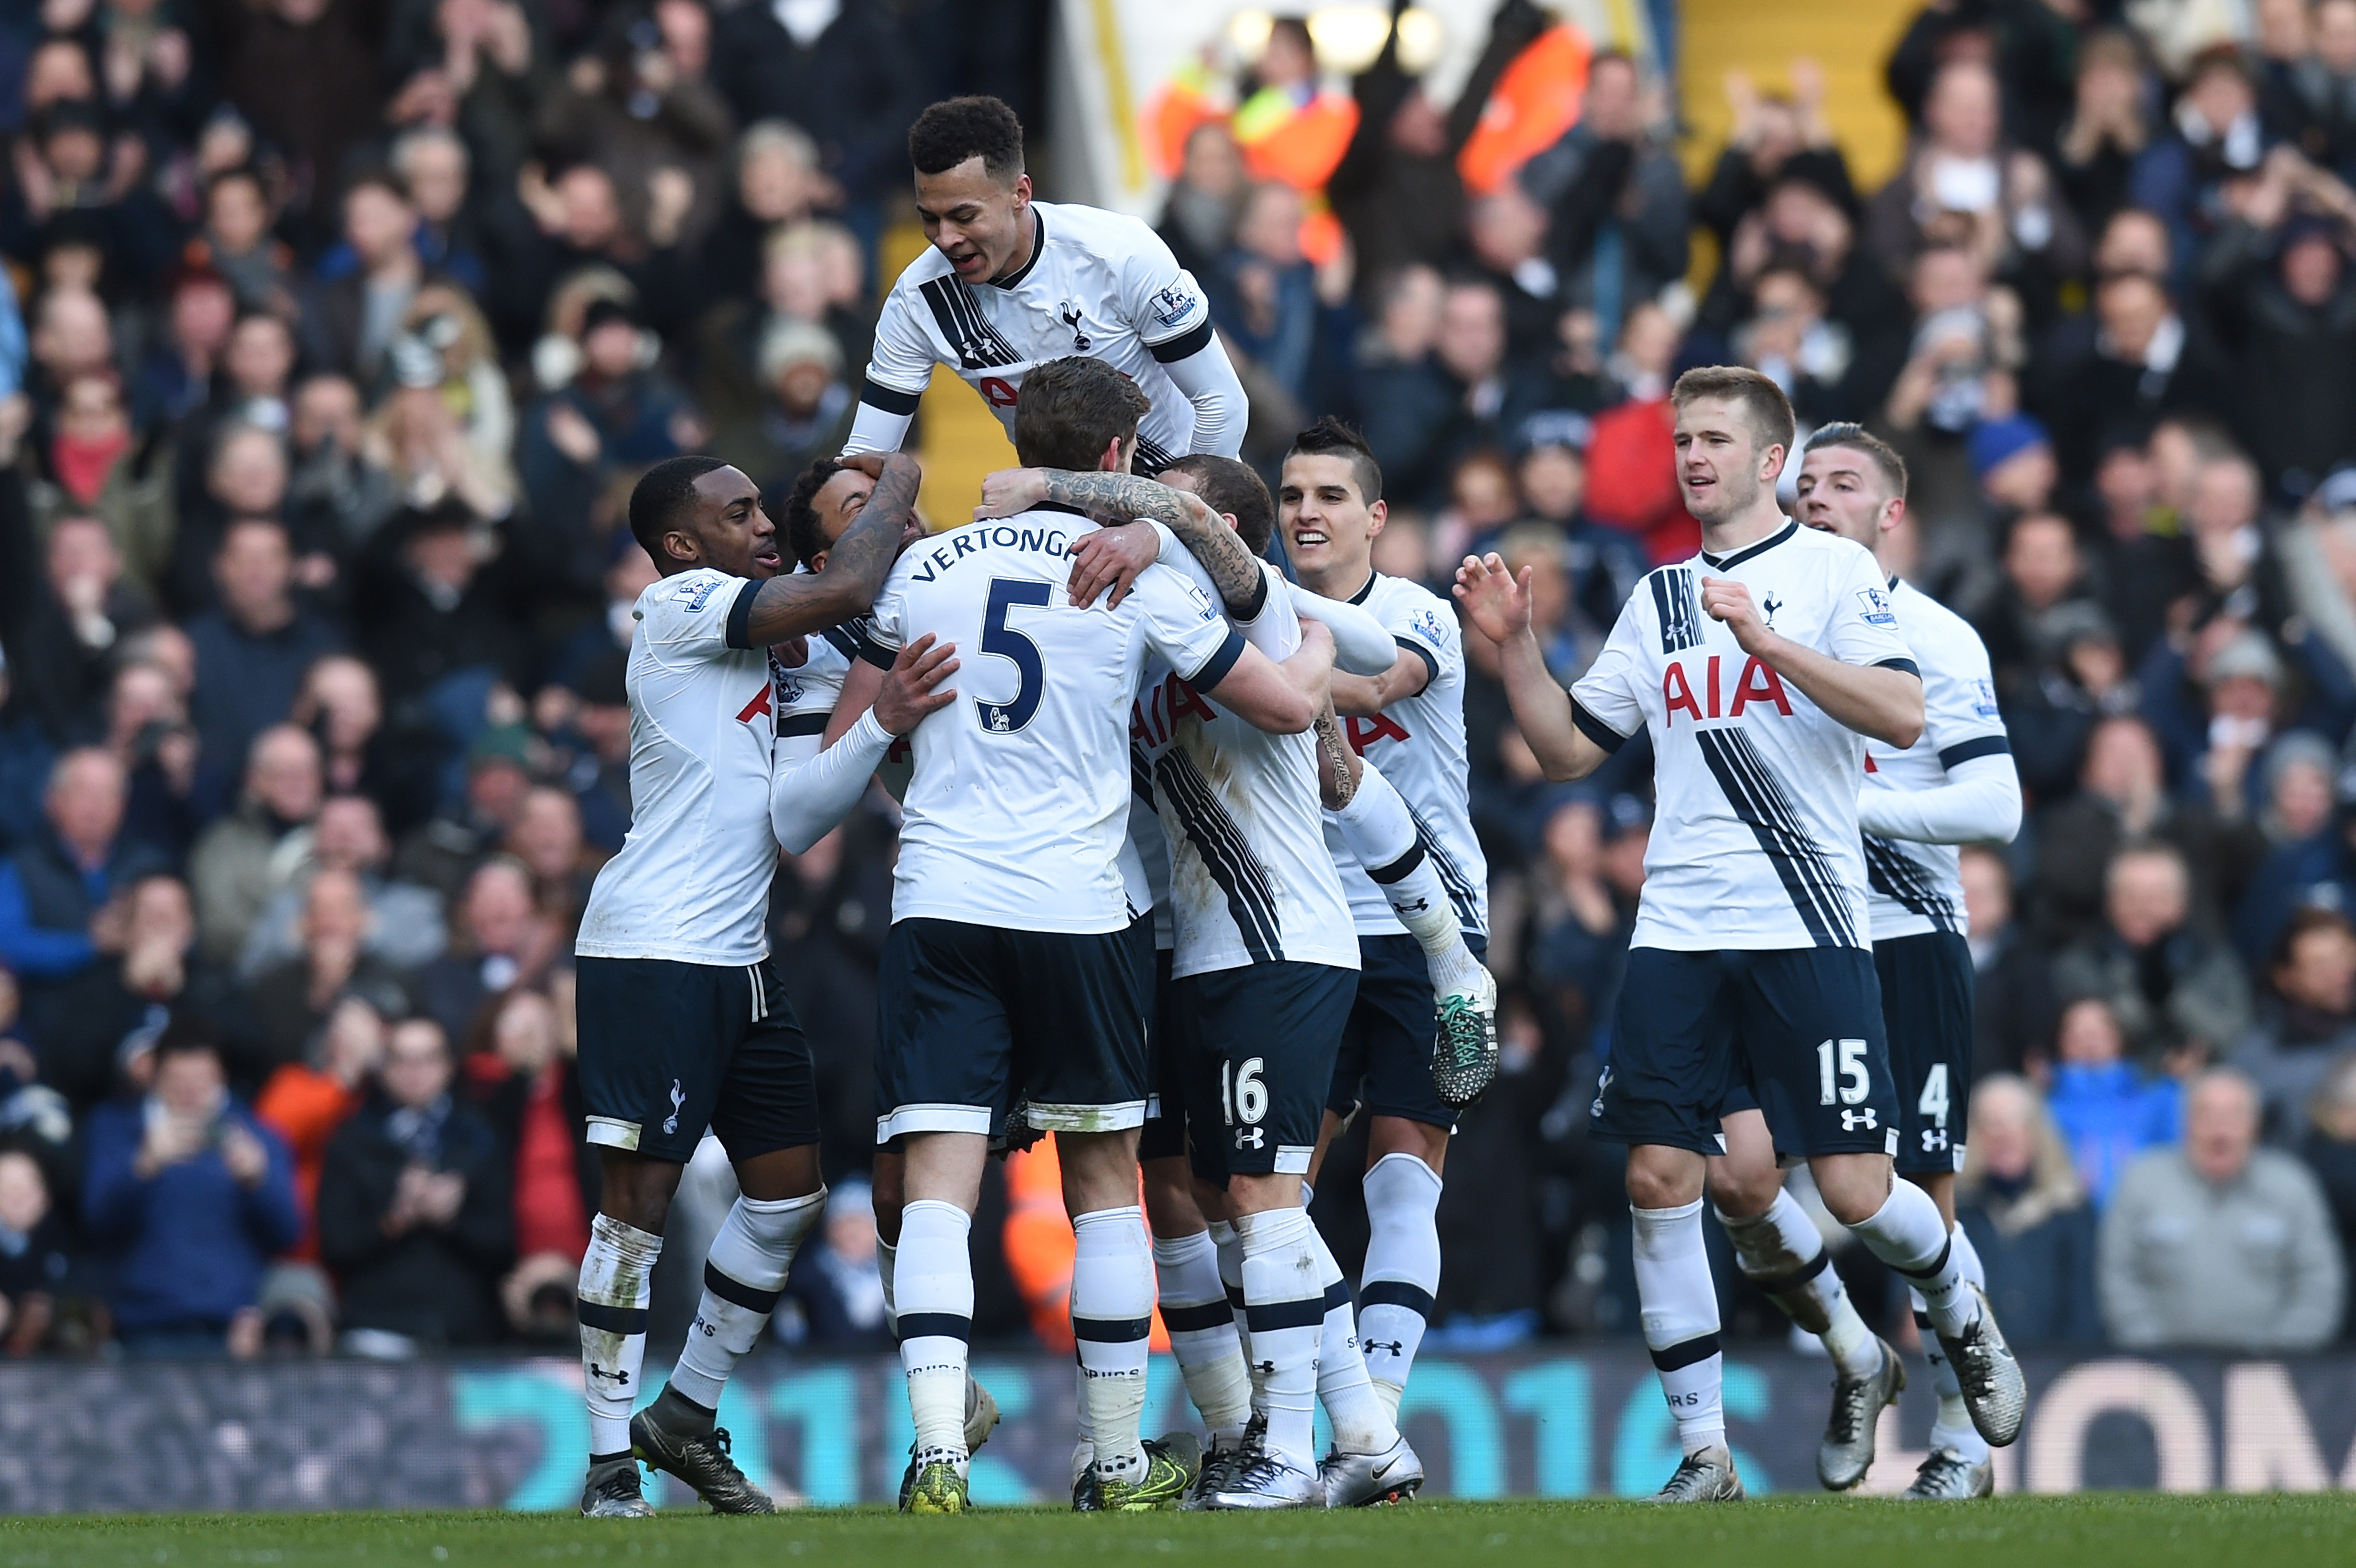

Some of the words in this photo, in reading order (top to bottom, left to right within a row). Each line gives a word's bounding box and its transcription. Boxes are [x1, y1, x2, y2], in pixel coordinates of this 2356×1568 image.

[911, 527, 1135, 602] VERTONGN
[972, 576, 1055, 735] 5
[1663, 655, 1794, 729] AIA
[1221, 1057, 1268, 1125] 16
[1817, 1039, 1870, 1105] 15
[1918, 1063, 1949, 1128] 4
